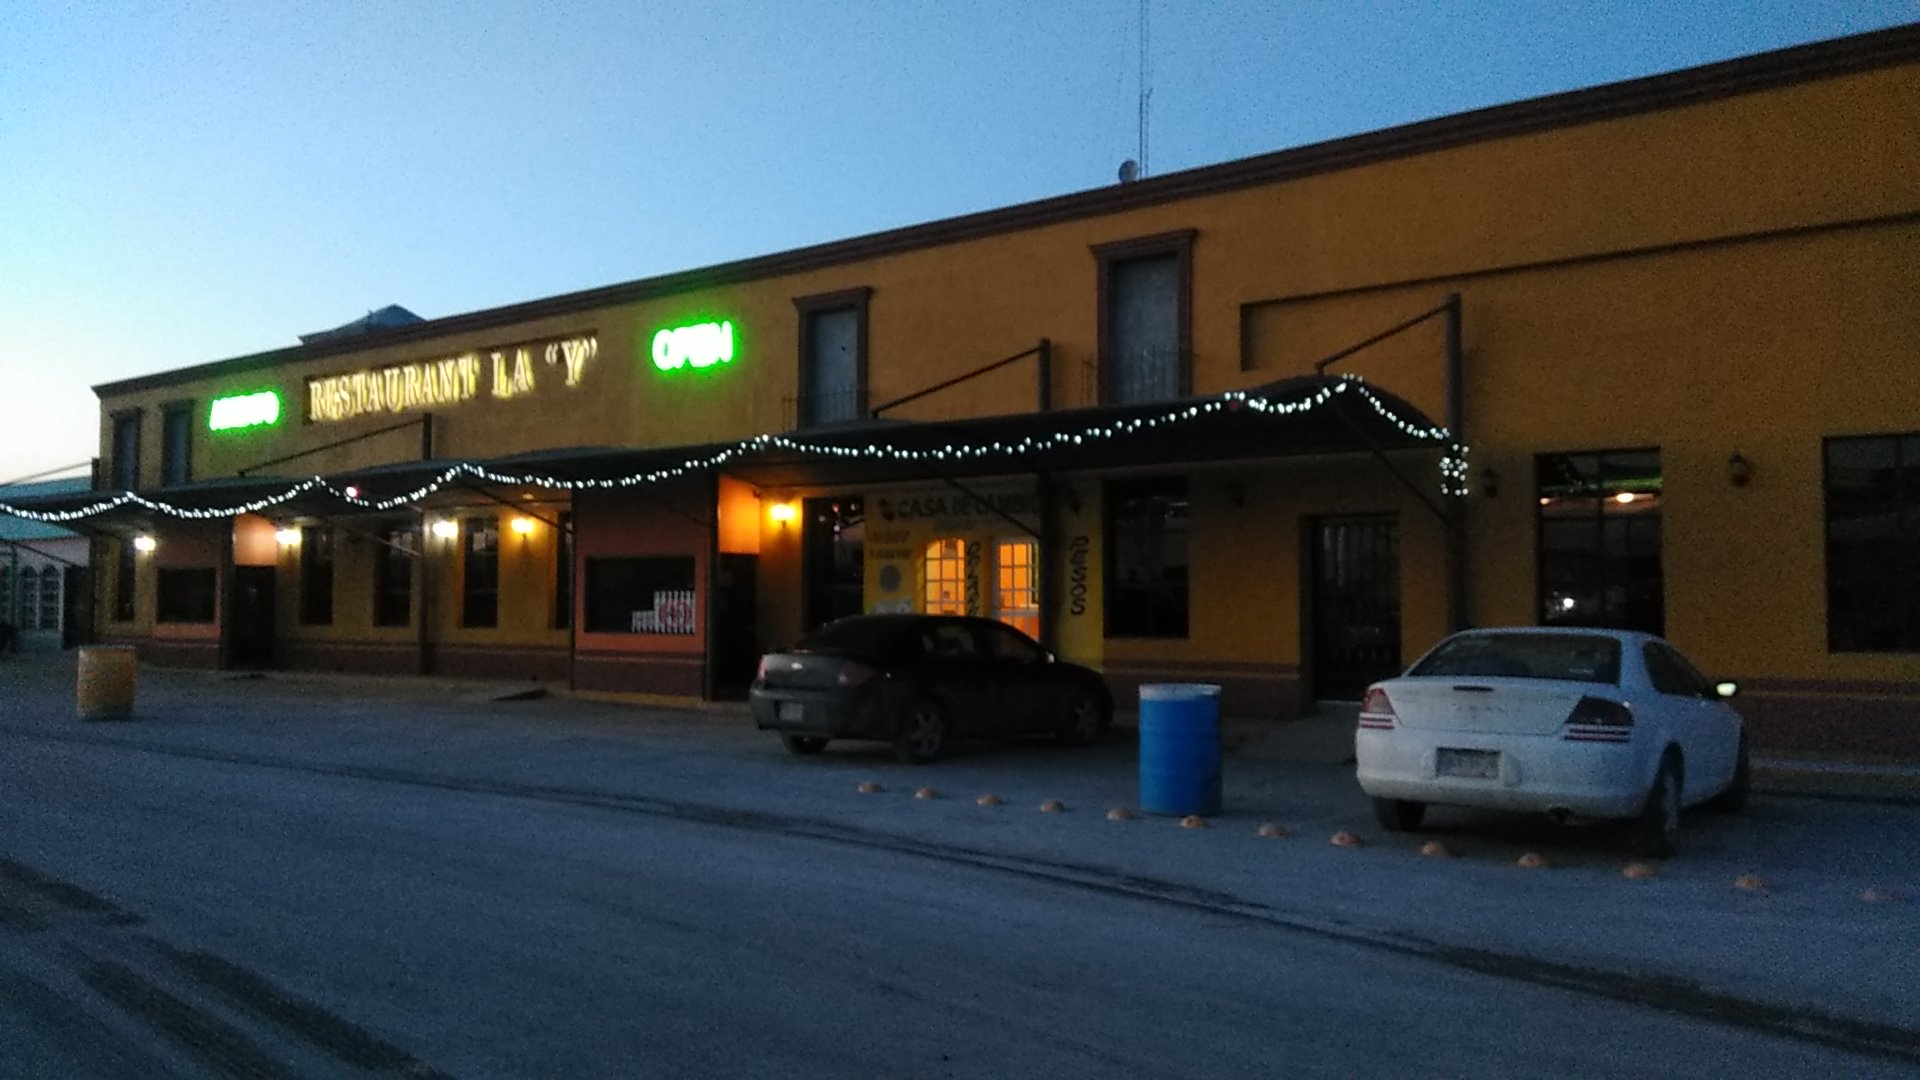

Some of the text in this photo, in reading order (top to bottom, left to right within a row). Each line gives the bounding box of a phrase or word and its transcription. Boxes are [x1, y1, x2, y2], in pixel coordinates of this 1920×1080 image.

[308, 354, 480, 421] RESTAURANT
[490, 347, 535, 398] LA
[898, 496, 947, 518] CASA
[952, 495, 971, 516] DE
